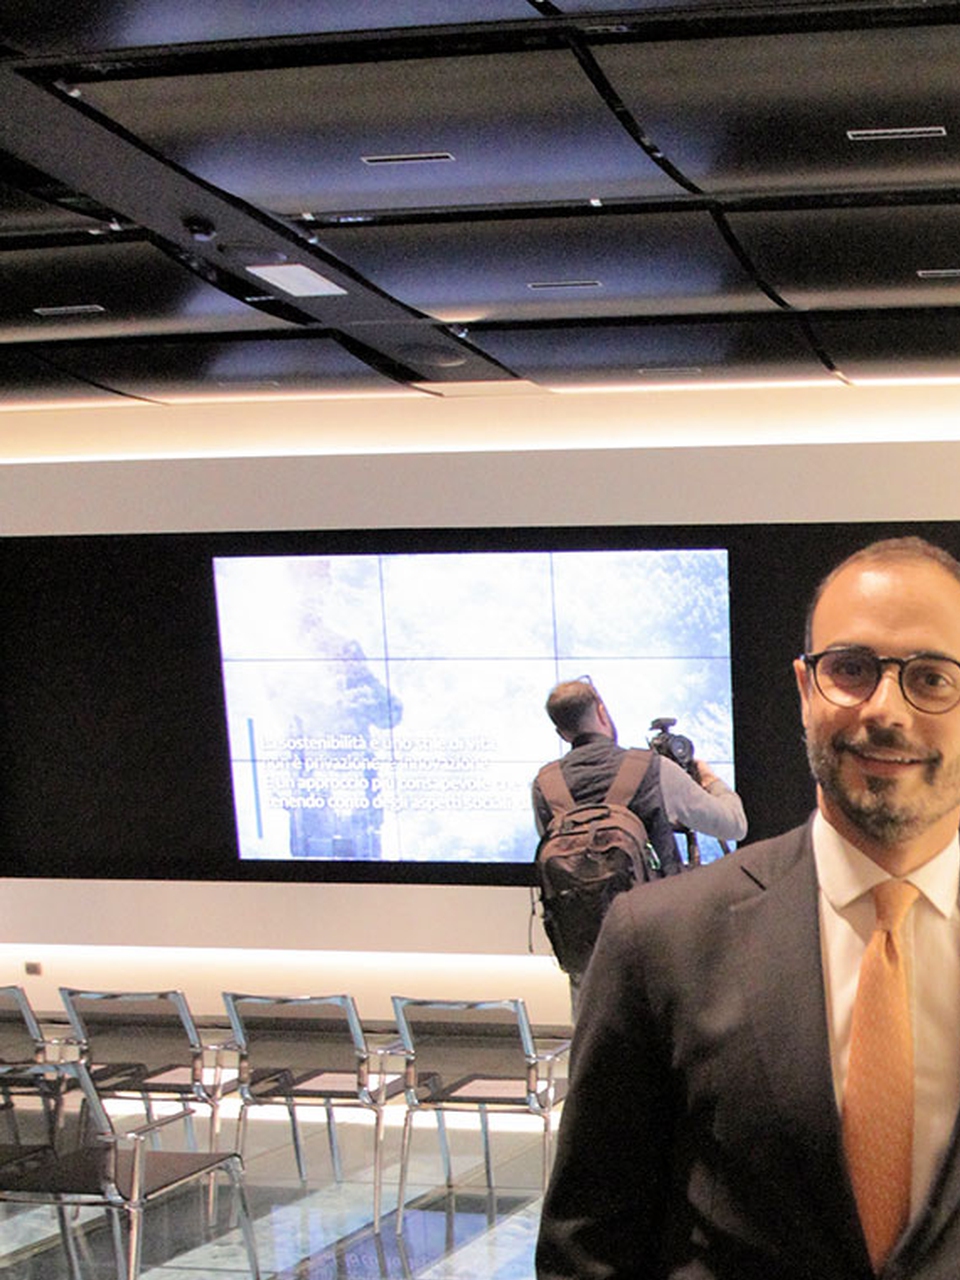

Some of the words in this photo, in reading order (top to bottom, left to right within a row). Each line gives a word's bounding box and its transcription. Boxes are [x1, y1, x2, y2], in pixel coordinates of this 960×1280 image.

[281, 734, 367, 750] sostenibilità
[292, 754, 302, 769] è
[276, 777, 295, 789] un
[297, 776, 369, 793] approccio
[372, 775, 394, 793] più
[399, 776, 492, 792] consapevole
[266, 794, 325, 808] tenendo
[328, 796, 370, 809] conto
[372, 794, 408, 813] degli
[411, 795, 462, 812] aspetti
